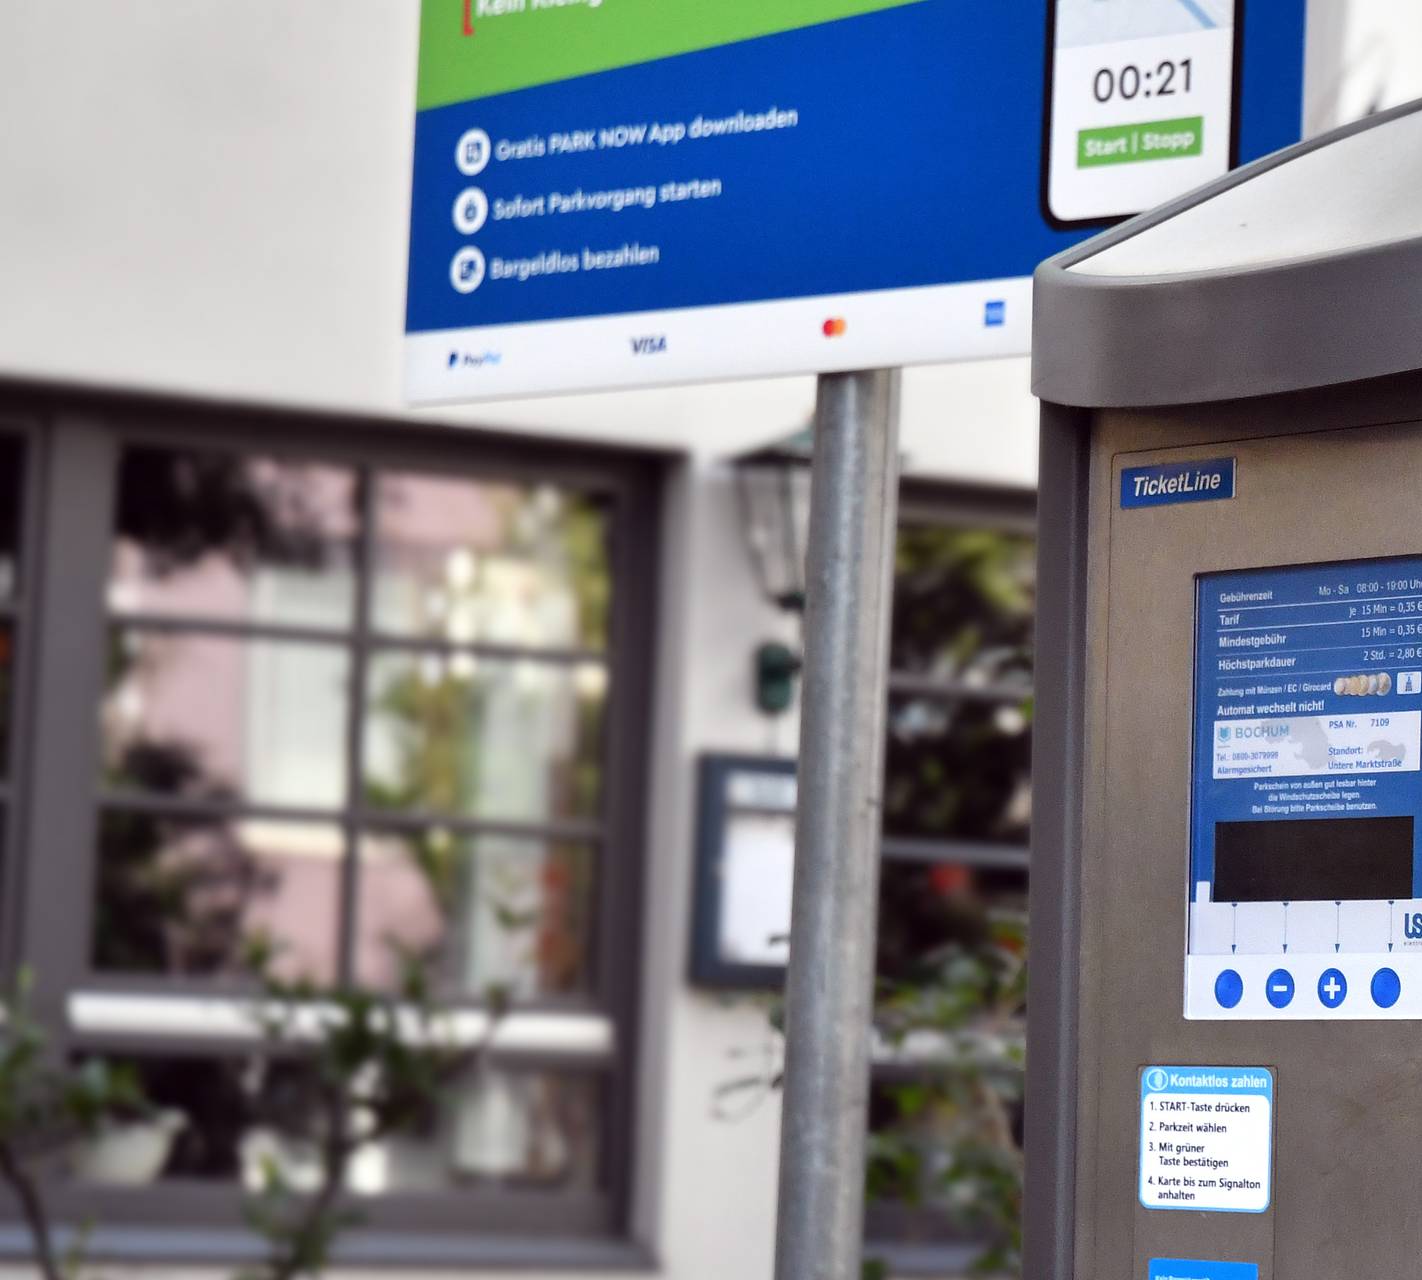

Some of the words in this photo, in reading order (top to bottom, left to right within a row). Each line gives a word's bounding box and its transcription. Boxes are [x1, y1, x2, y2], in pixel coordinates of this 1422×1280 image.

[1093, 59, 1193, 102] 00:21
[495, 135, 545, 161] Gratis
[549, 131, 595, 154] PARK
[599, 125, 648, 149] NOW
[648, 122, 686, 146] App
[688, 107, 798, 138] downloaden
[1085, 136, 1127, 157] Start
[1142, 132, 1195, 151] Stopp
[493, 195, 545, 220] Sofort
[549, 187, 656, 213] Parkvorgang
[659, 178, 722, 202] starten
[490, 249, 579, 281] Bargeldlos
[583, 242, 660, 270] bezahlen
[632, 336, 667, 354] VISA
[1134, 471, 1220, 496] TicketLine
[1220, 591, 1273, 603] Gebührenzeit
[1319, 586, 1331, 595] Mo
[1338, 585, 1349, 594] Sa
[1357, 582, 1378, 593] 08:00
[1387, 580, 1408, 591] 19:00
[1220, 614, 1240, 625] Tarif
[1349, 606, 1357, 618] je
[1362, 605, 1371, 615] 15
[1373, 603, 1387, 614] Min
[1398, 601, 1415, 613] 0,35
[1417, 601, 1422, 611] €
[1219, 634, 1286, 648] Mindestgebühr
[1361, 627, 1370, 638] 15
[1373, 626, 1386, 636] Min
[1397, 624, 1415, 636] 0,35
[1417, 624, 1422, 633] €
[1218, 657, 1296, 670] Höchstparkdauer
[1363, 651, 1369, 660] 2
[1370, 650, 1386, 660] Std.
[1397, 648, 1414, 659] 2,80
[1417, 648, 1422, 657] €
[1288, 684, 1297, 692] EC
[1302, 682, 1332, 691] Girocard
[1217, 703, 1254, 716] Automat
[1257, 701, 1296, 714] wechselt
[1299, 699, 1324, 712] nicht!
[1235, 725, 1289, 738] BOCHUM
[1329, 720, 1343, 728] PSA
[1346, 720, 1357, 728] Nr.
[1371, 718, 1390, 727] 7109
[1170, 1074, 1228, 1088] Kontaktlos
[1231, 1075, 1267, 1088] zahlen
[1150, 1102, 1157, 1111] 1.
[1159, 1101, 1212, 1112] START-Taste
[1215, 1102, 1250, 1113] drücken
[1159, 1122, 1193, 1132] Parkzeit
[1196, 1123, 1227, 1133] wählen
[1159, 1142, 1173, 1152] Mit
[1176, 1143, 1204, 1155] grüner
[1159, 1156, 1180, 1166] Taste
[1183, 1157, 1228, 1170] bestätigen
[1158, 1176, 1180, 1186] Karte
[1183, 1176, 1196, 1187] bis
[1198, 1179, 1216, 1188] zum
[1219, 1177, 1260, 1191] Signalton
[1158, 1190, 1195, 1201] anhalten
